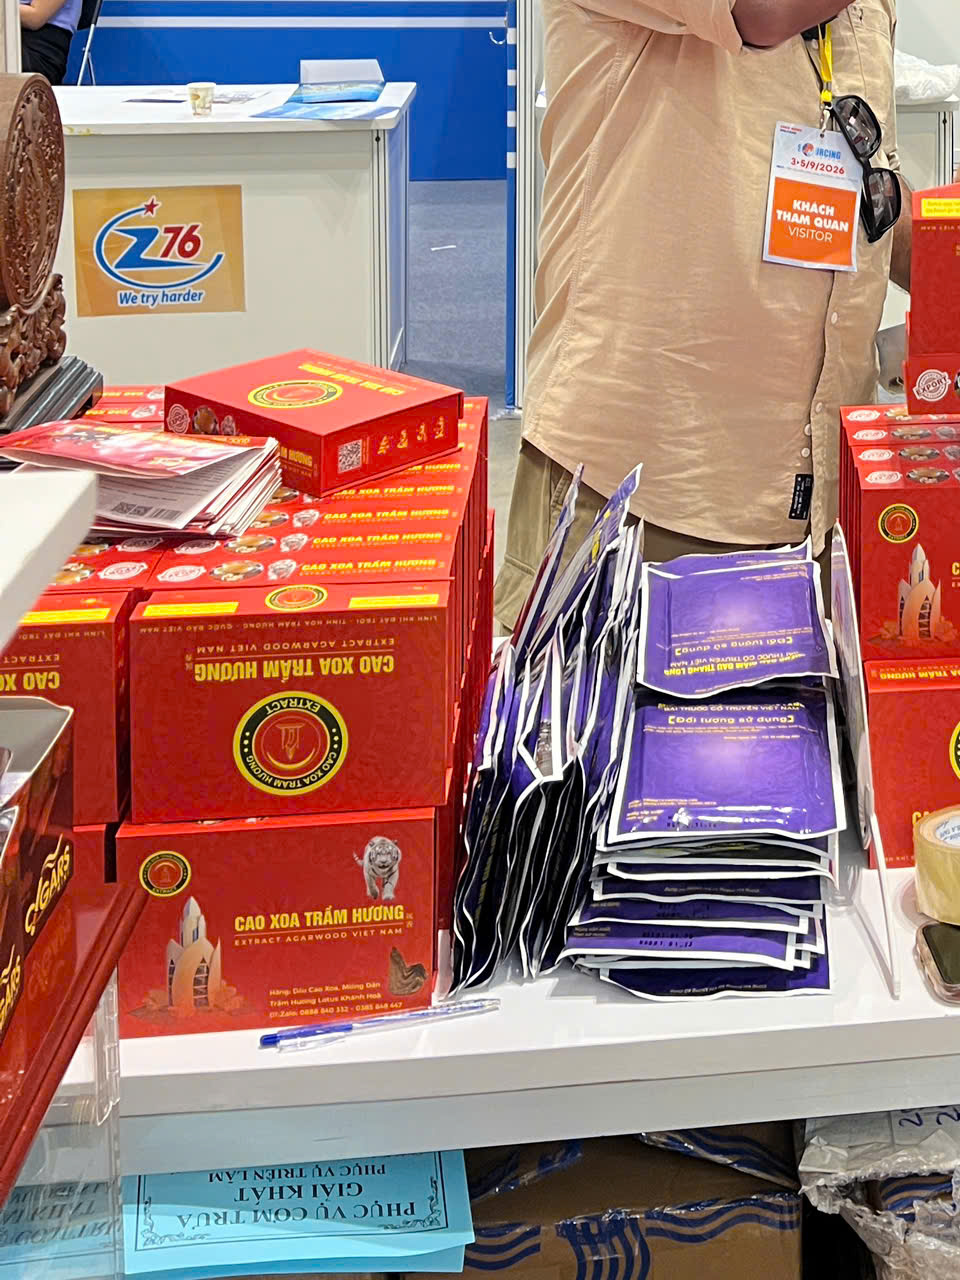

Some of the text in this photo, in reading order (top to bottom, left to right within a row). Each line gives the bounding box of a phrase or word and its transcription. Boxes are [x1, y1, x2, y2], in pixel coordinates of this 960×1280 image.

[793, 198, 835, 217] KHÁCH
[776, 209, 849, 232] THAM QUAN
[788, 226, 833, 243] VISITOR
[118, 289, 204, 308] We try harder
[194, 654, 394, 683] CAO XOA TRẦM HƯƠNG
[234, 915, 265, 932] CAO
[270, 913, 300, 930] XOA
[352, 904, 404, 924] HƯƠNG
[234, 927, 403, 947] EXTRACT AGARWOOD VIET NAM
[234, 1179, 362, 1204] GIẢI KHÁT
[177, 1201, 416, 1229] PHỤC VỤ CƠM TRƯA
